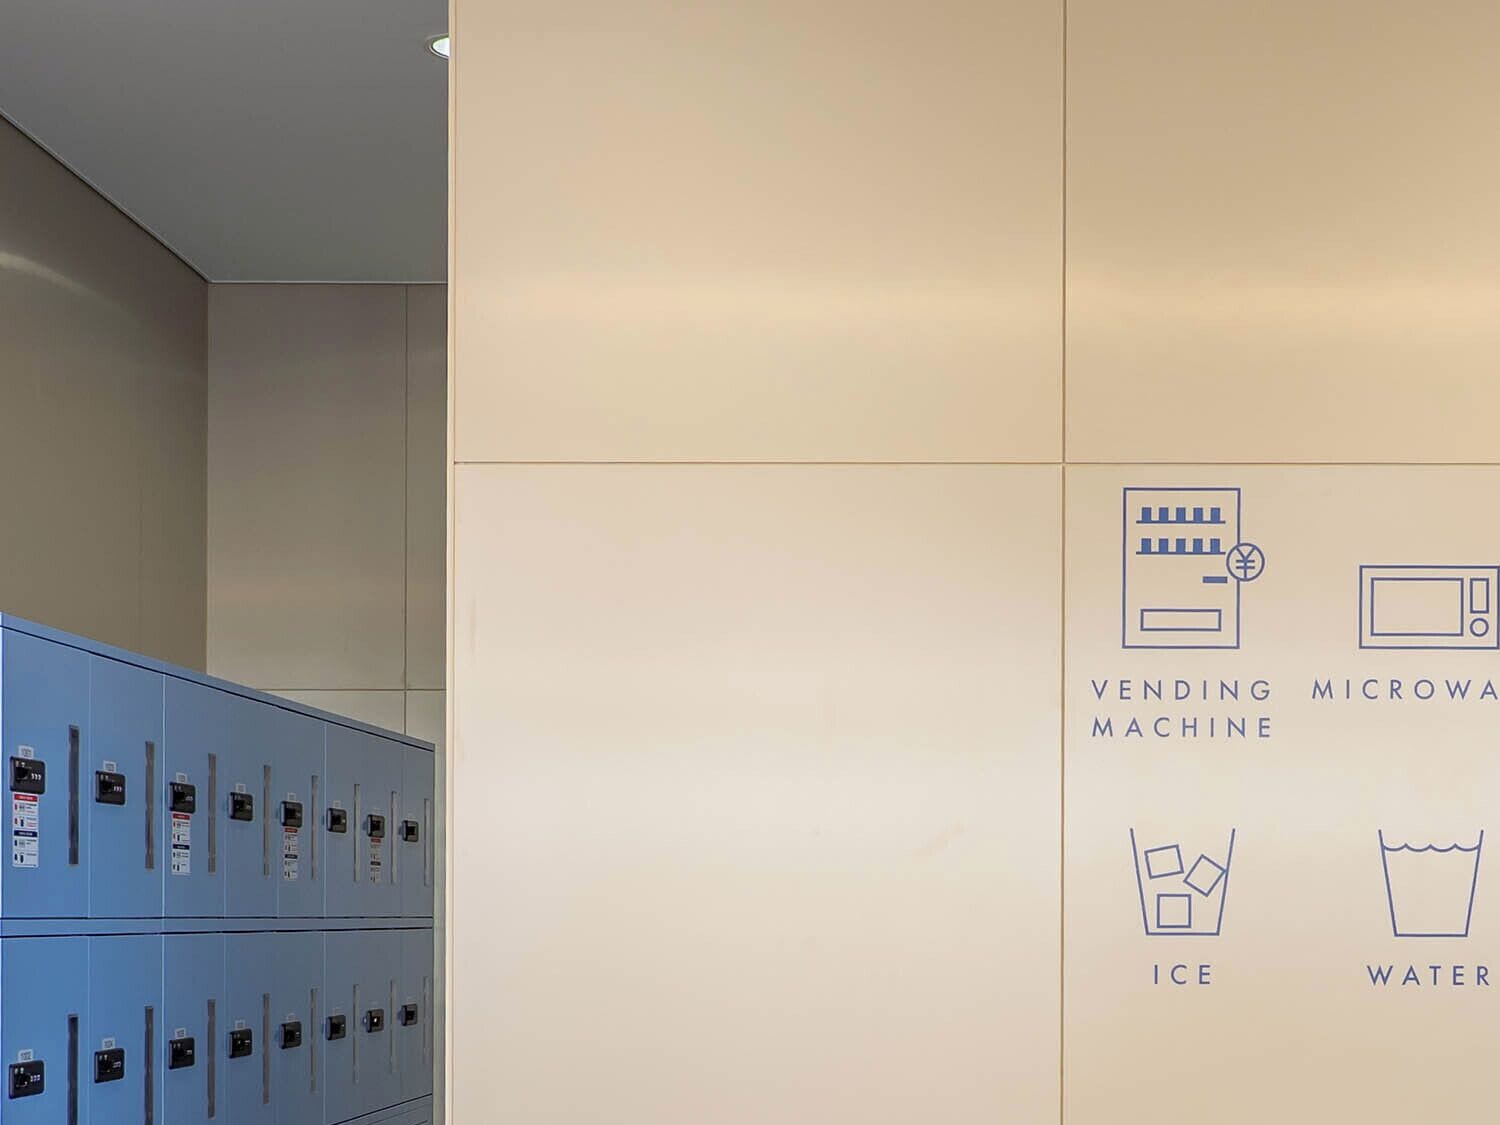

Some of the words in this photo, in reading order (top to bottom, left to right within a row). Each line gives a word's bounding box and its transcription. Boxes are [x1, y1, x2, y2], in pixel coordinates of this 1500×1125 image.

[1091, 679, 1271, 701] VENDING
[1091, 717, 1271, 738] MACHINE
[1153, 964, 1212, 986] ICE
[1367, 965, 1490, 986] WATER
